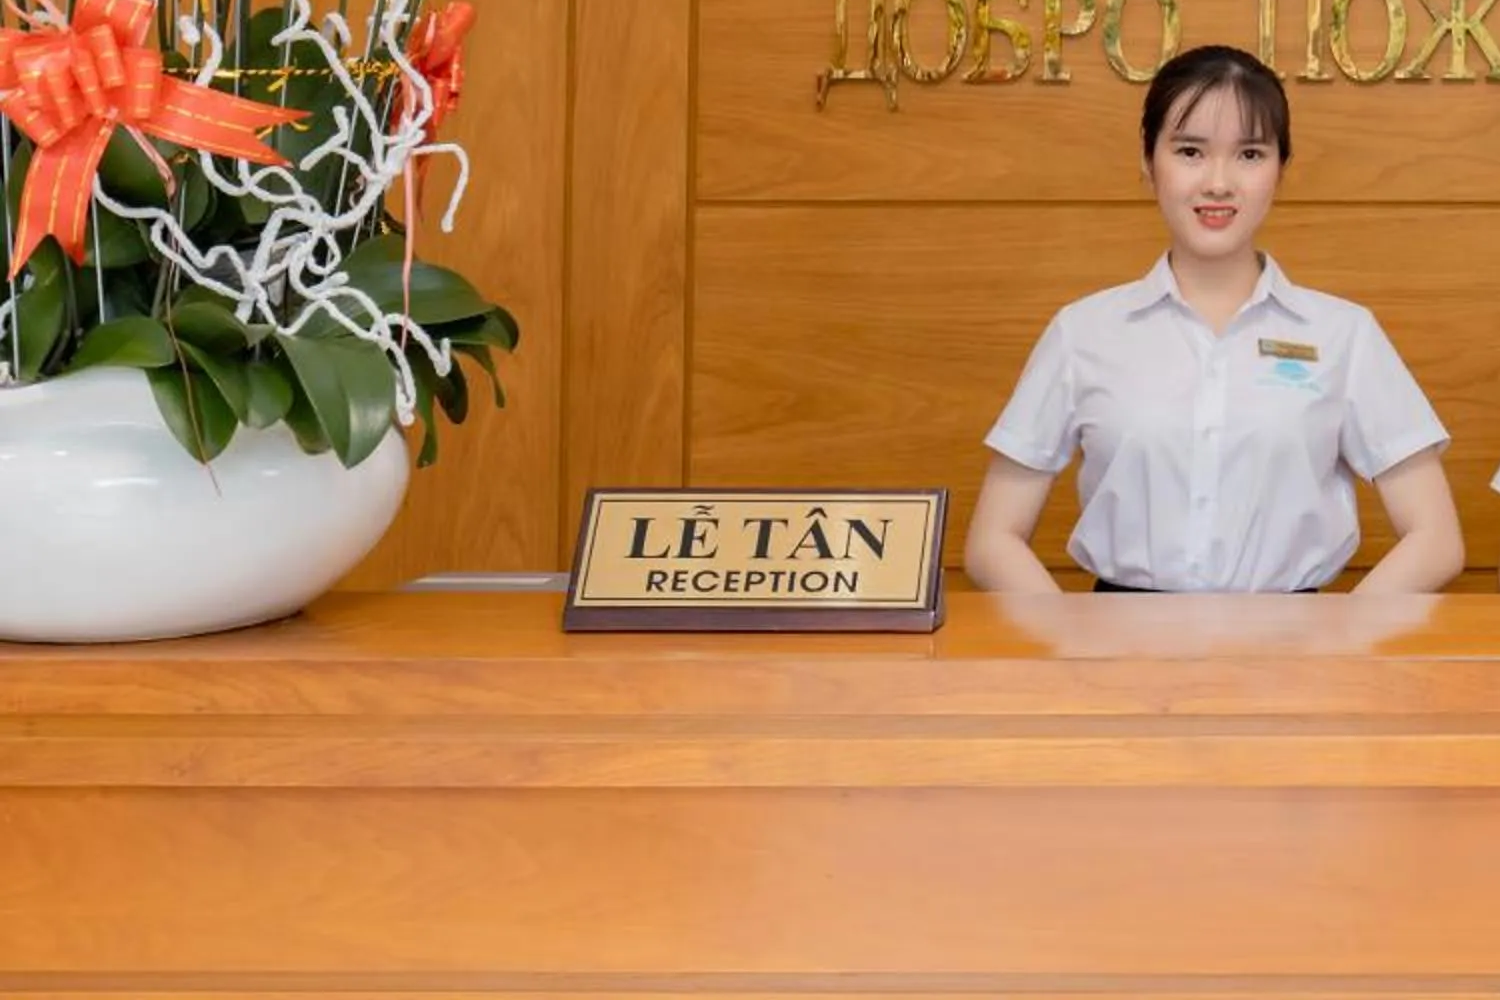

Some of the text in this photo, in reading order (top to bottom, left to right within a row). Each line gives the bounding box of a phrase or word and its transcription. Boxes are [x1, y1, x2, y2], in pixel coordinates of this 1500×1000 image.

[624, 504, 894, 561] LỄ TÂN
[645, 569, 859, 594] RECEPTION
